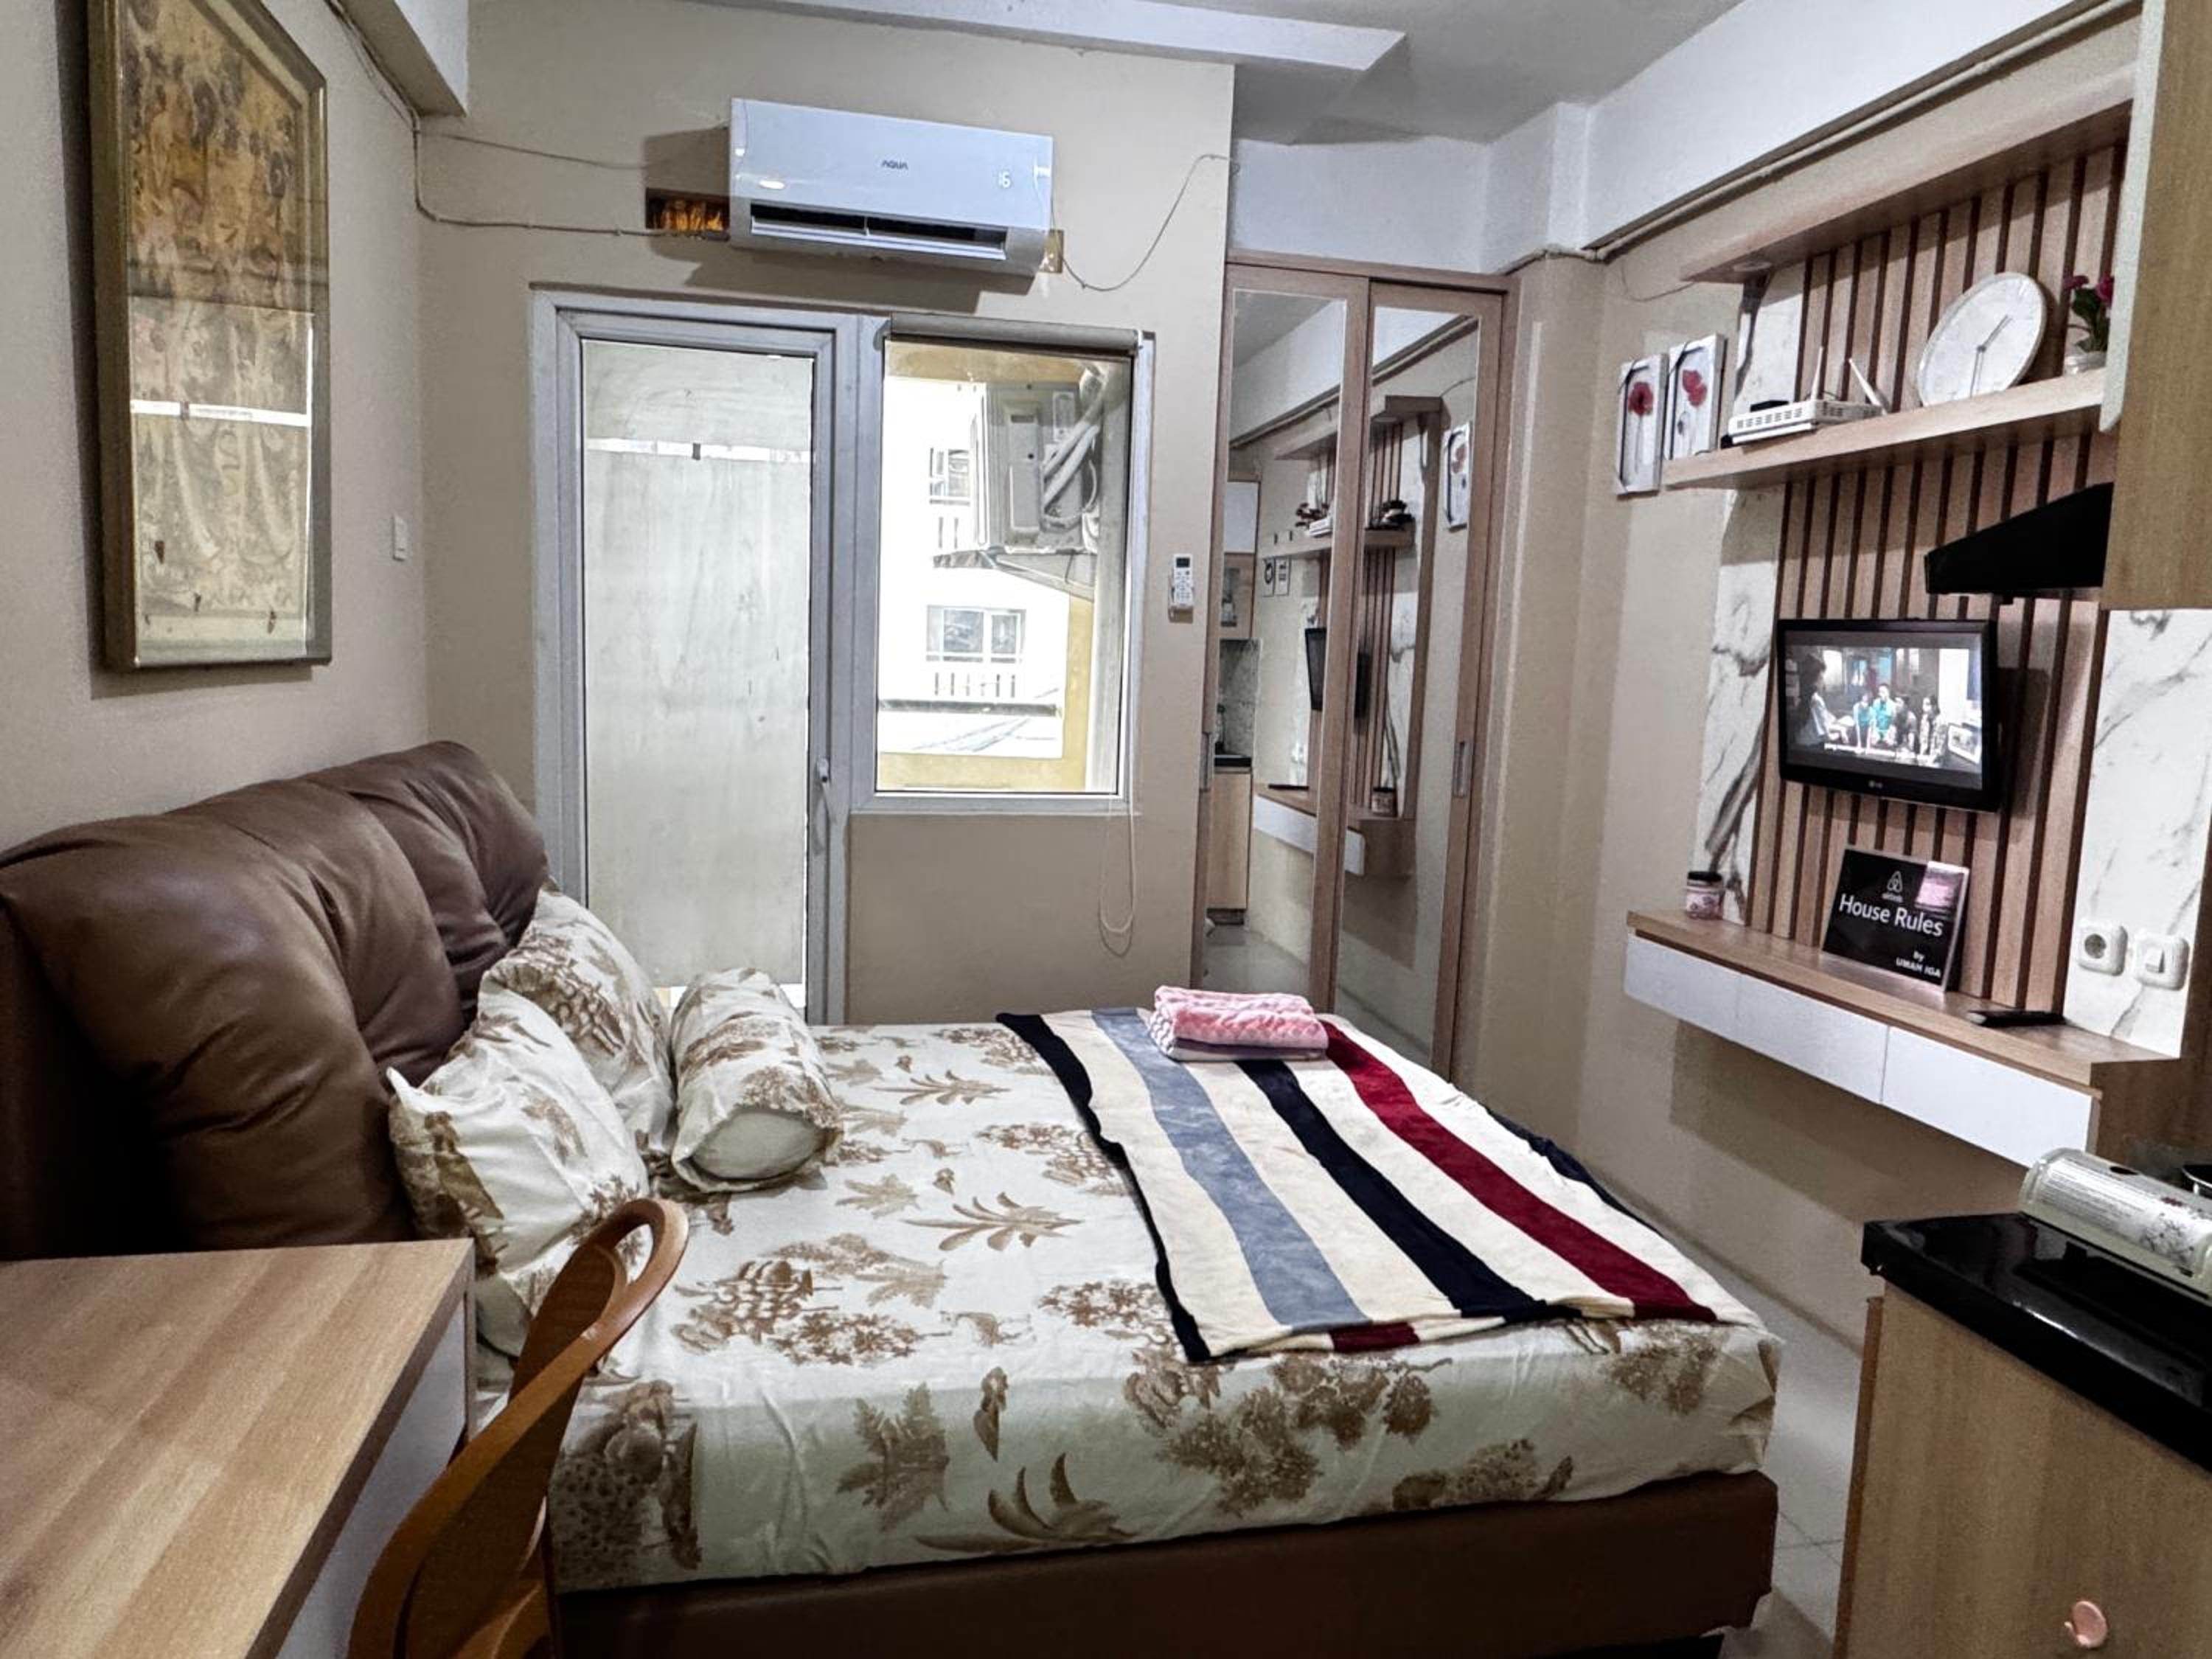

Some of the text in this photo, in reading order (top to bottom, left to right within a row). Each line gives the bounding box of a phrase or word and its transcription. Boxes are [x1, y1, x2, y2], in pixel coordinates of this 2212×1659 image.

[880, 159, 909, 170] AQUA
[1839, 893, 1944, 937] House Rules
